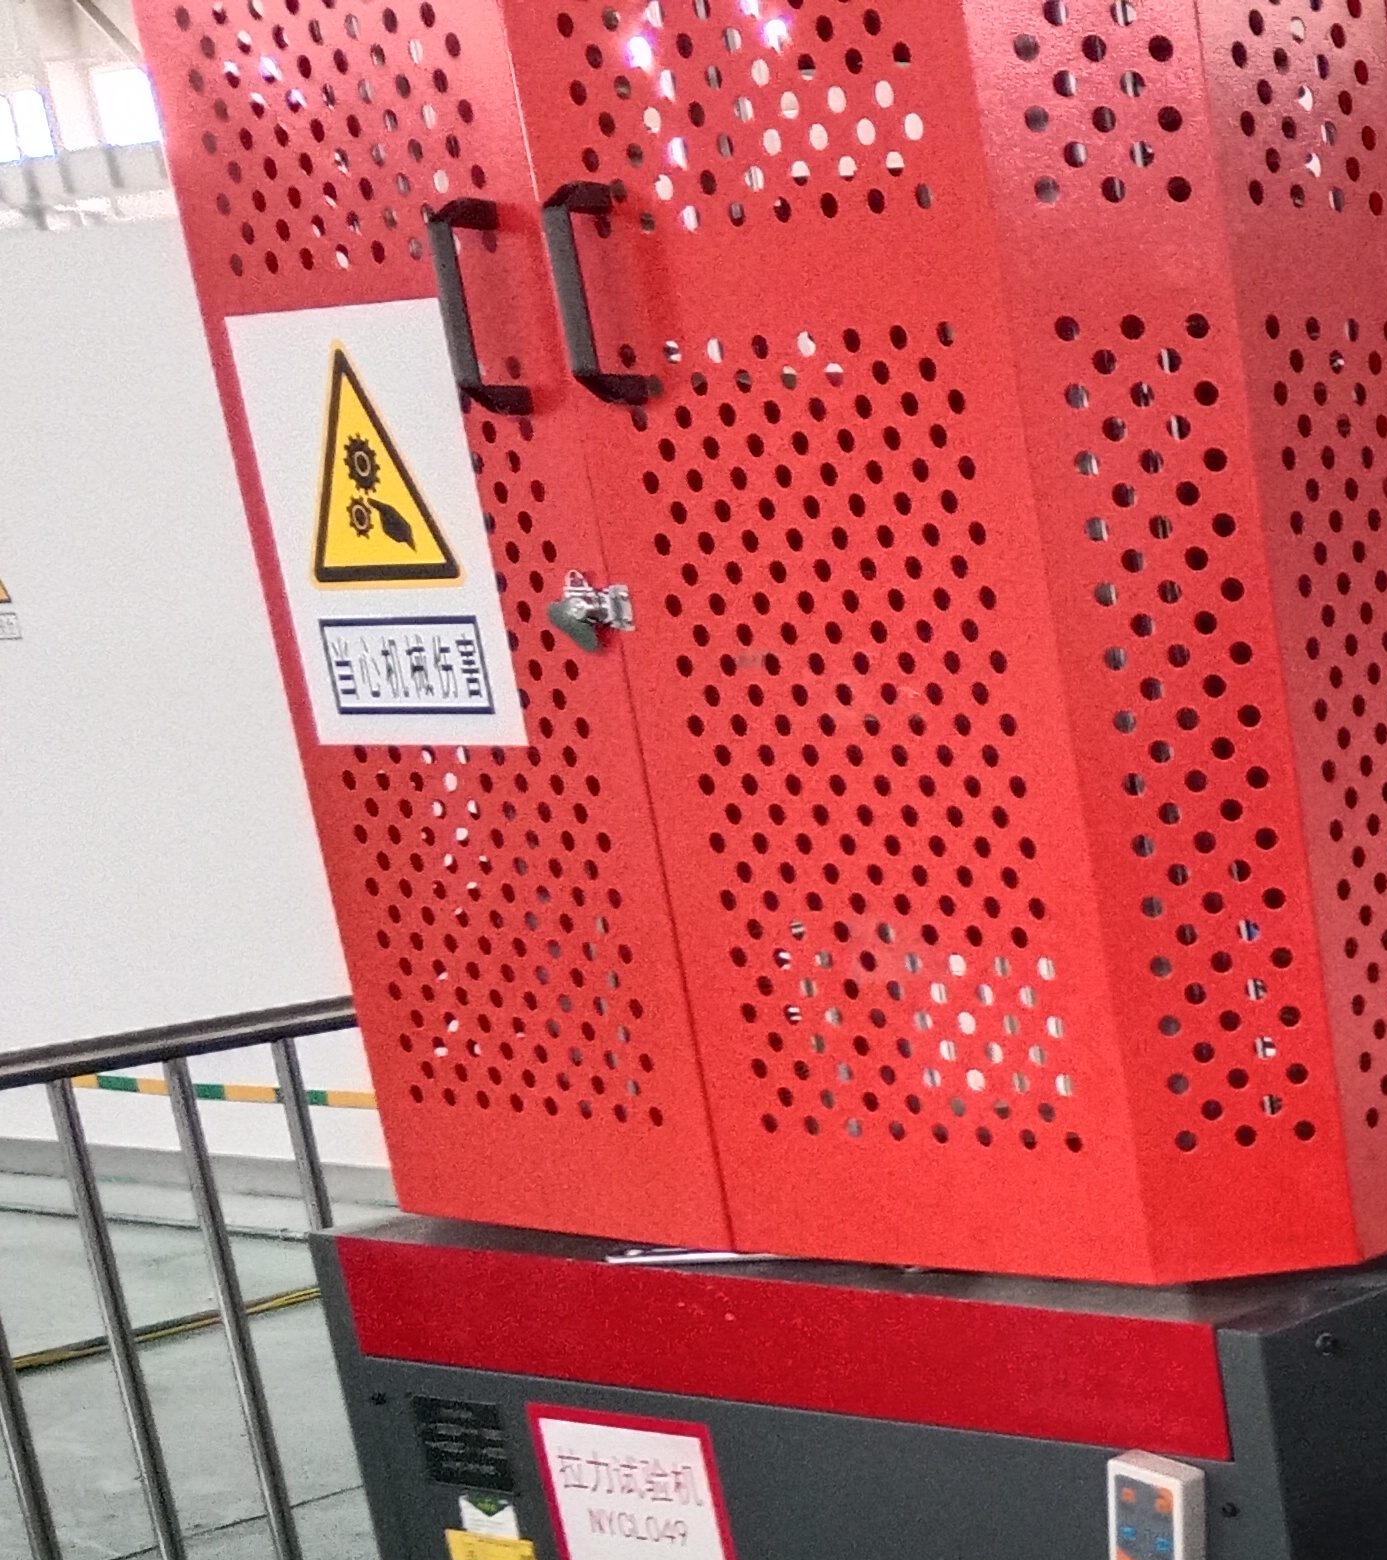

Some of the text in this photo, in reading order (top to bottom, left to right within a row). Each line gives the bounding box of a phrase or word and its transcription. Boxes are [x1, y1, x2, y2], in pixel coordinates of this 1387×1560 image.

[331, 633, 482, 699] 当心机械伤害
[557, 1445, 705, 1506] 拉力试验机
[588, 1507, 689, 1547] NYCL049
